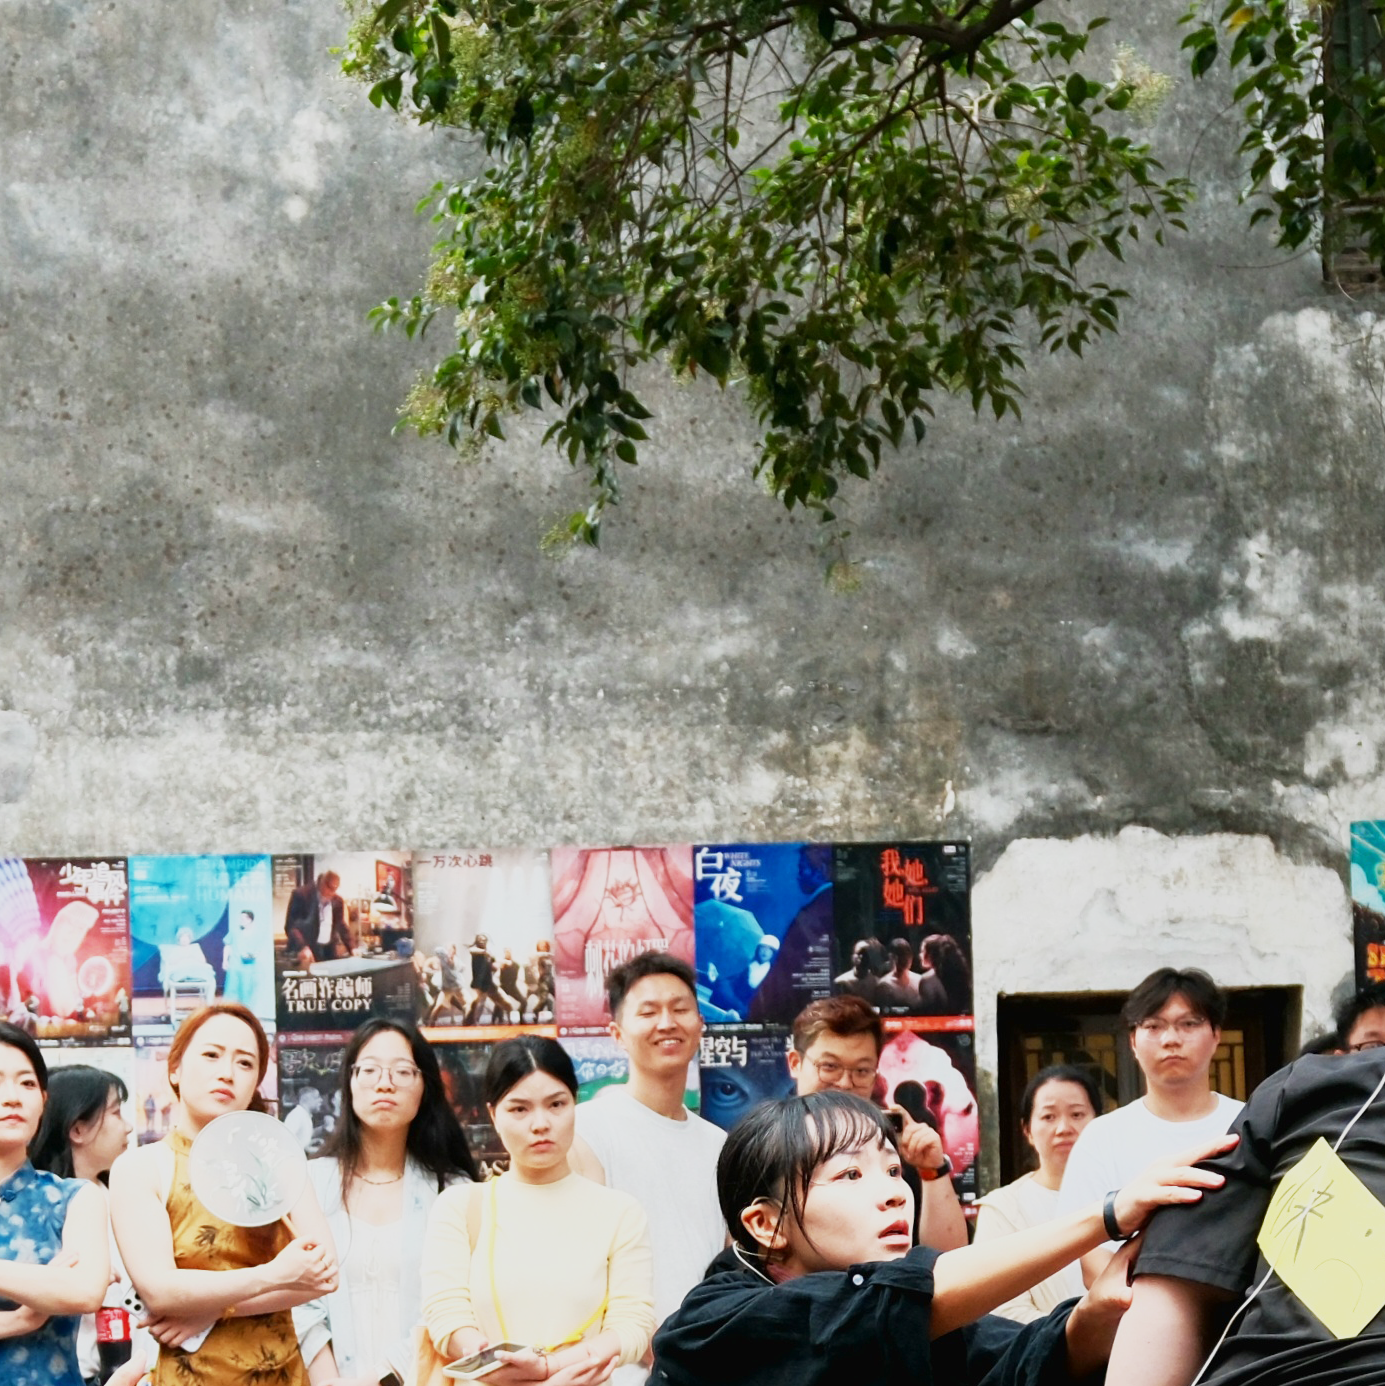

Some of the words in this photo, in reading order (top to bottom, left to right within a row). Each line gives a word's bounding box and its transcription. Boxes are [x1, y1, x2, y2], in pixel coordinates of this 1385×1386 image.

[695, 847, 744, 902] 白夜
[287, 1000, 327, 1012] TRUE
[331, 998, 373, 1012] COPY
